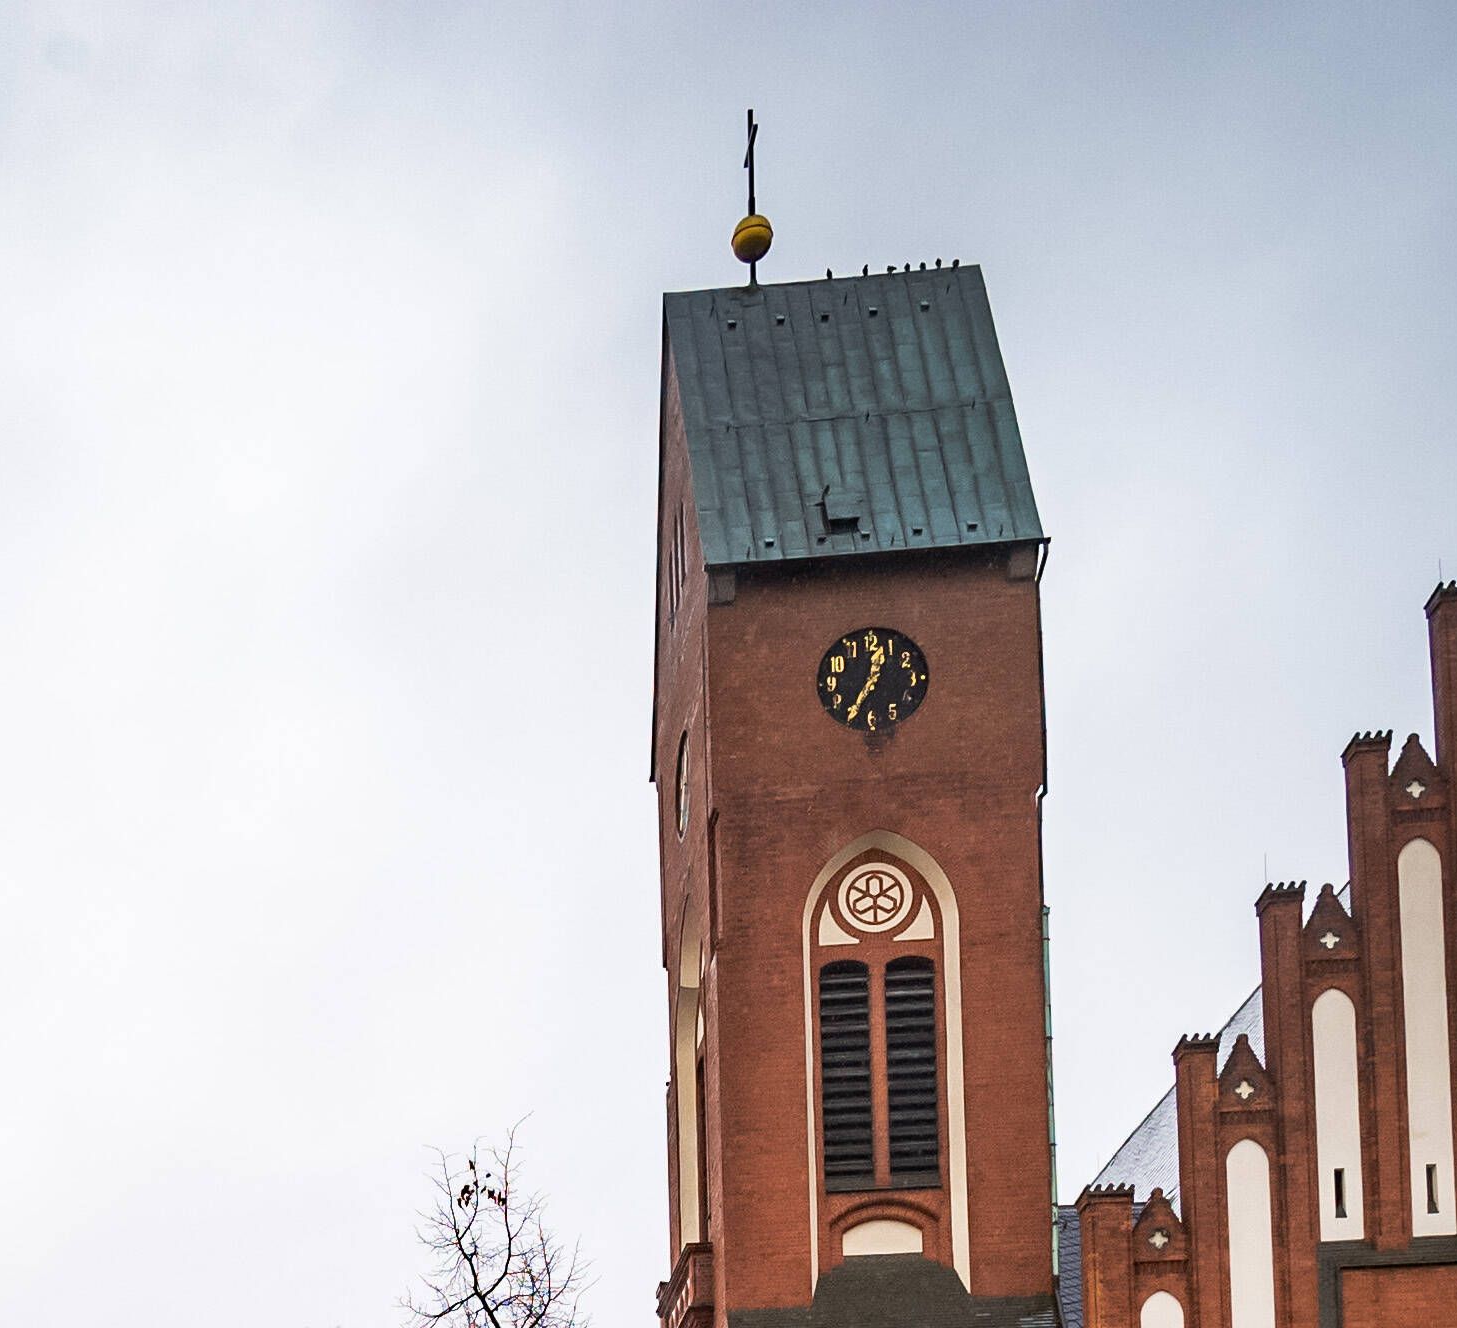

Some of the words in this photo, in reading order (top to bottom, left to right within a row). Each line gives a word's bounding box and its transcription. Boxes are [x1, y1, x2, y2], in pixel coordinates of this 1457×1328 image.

[864, 634, 878, 652] 12
[888, 639, 893, 656] 1
[830, 655, 845, 673] 10
[901, 651, 911, 668] 2
[826, 676, 837, 692] 9
[888, 703, 897, 720] 5
